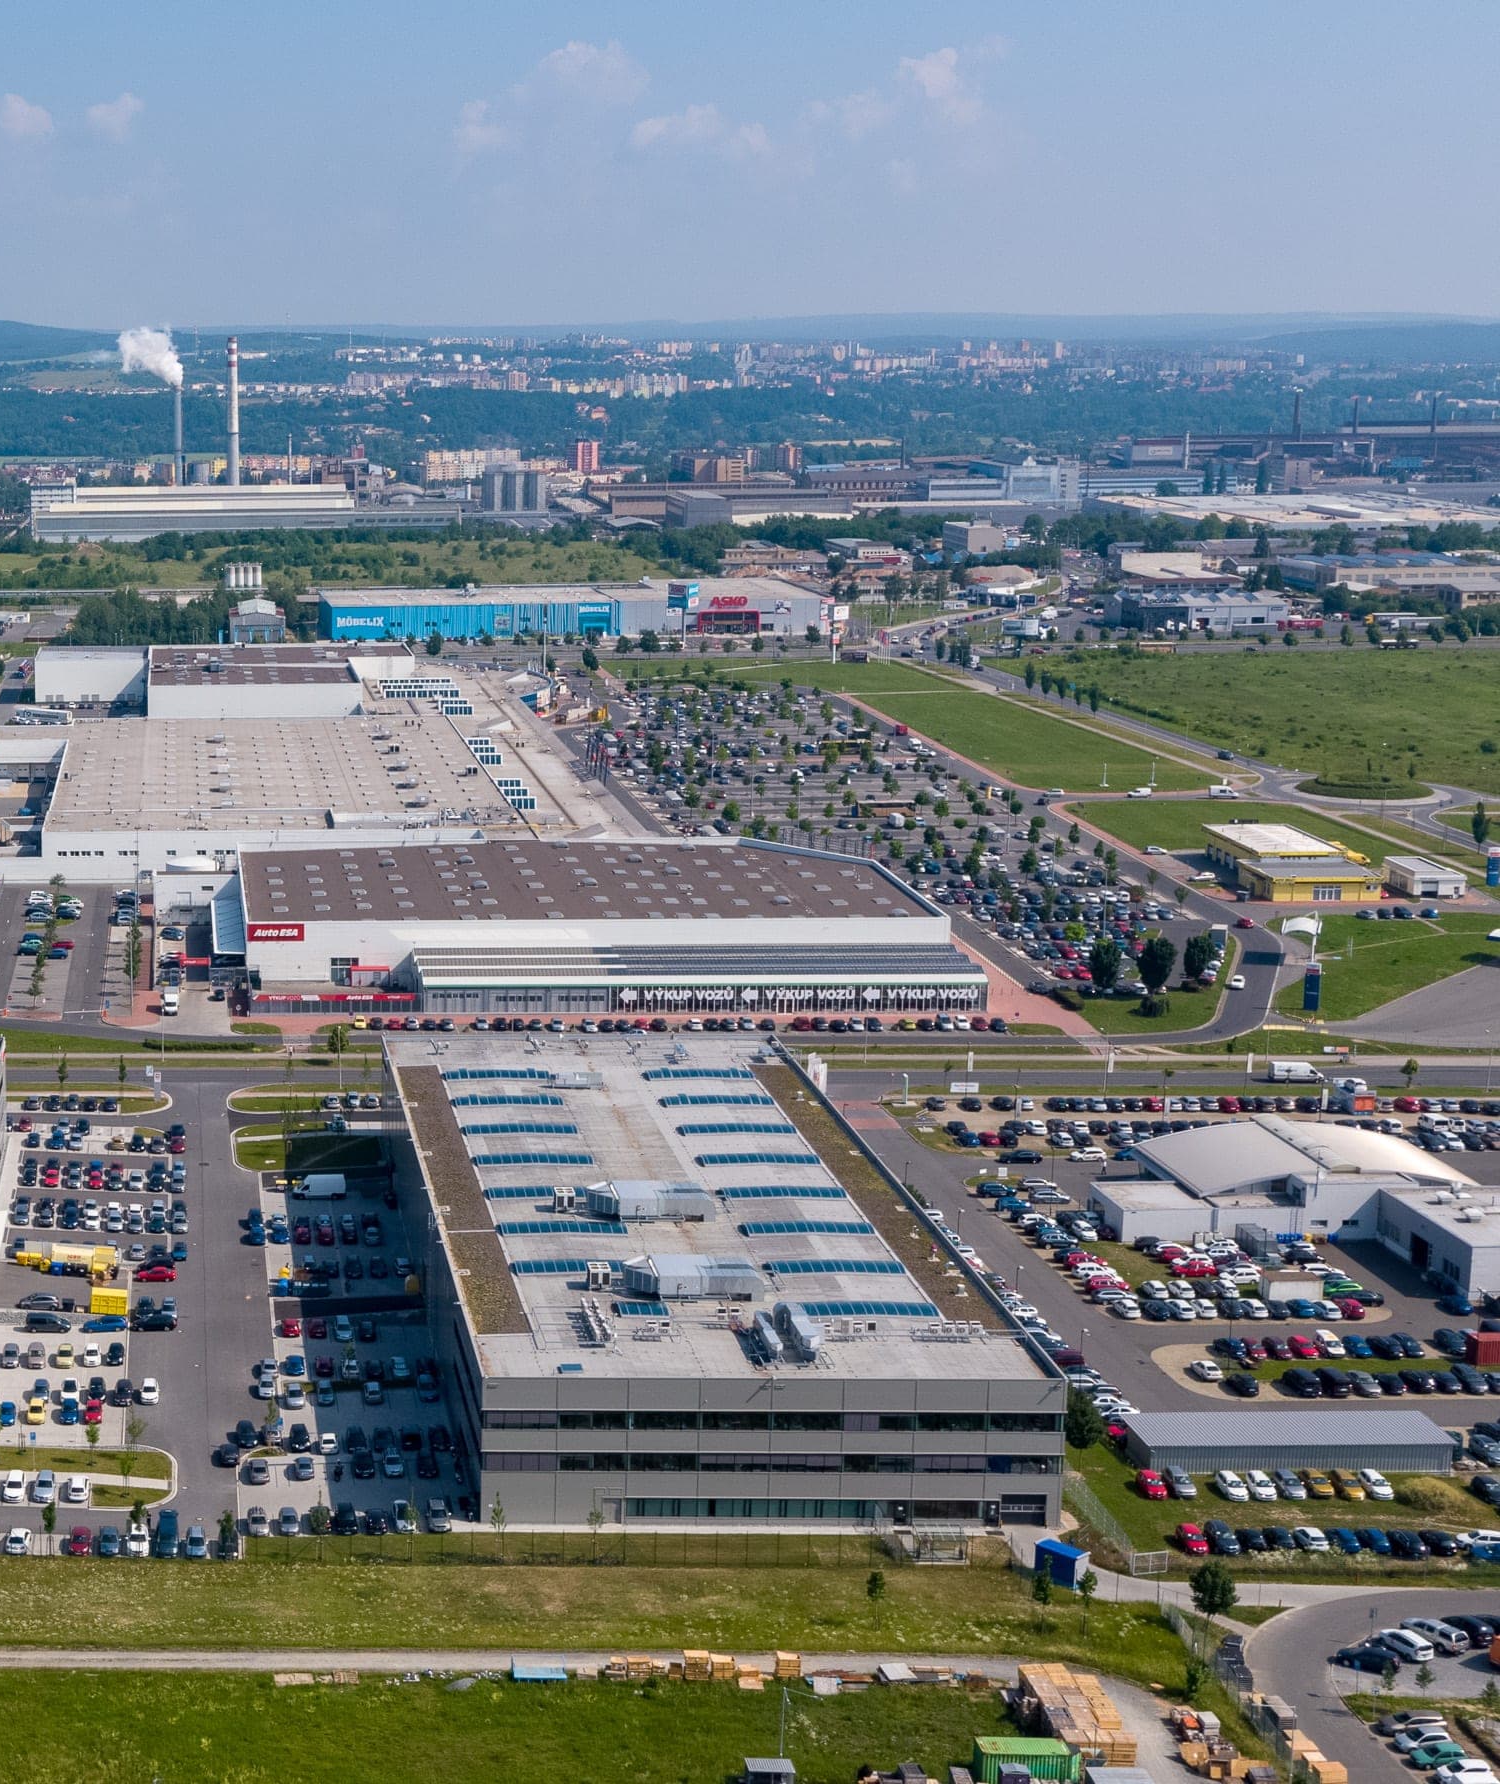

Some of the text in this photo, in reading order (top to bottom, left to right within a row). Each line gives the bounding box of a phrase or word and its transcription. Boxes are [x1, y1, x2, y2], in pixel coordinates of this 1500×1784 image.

[709, 596, 748, 608] ASKO
[336, 615, 385, 628] MÖBELIX
[253, 928, 299, 937] Auto ESA
[644, 986, 734, 1001] VÝKUP VOZŮ
[765, 986, 856, 1001] VÝKUP VOZŮ
[886, 985, 979, 1000] VÝKUP VOZŮ
